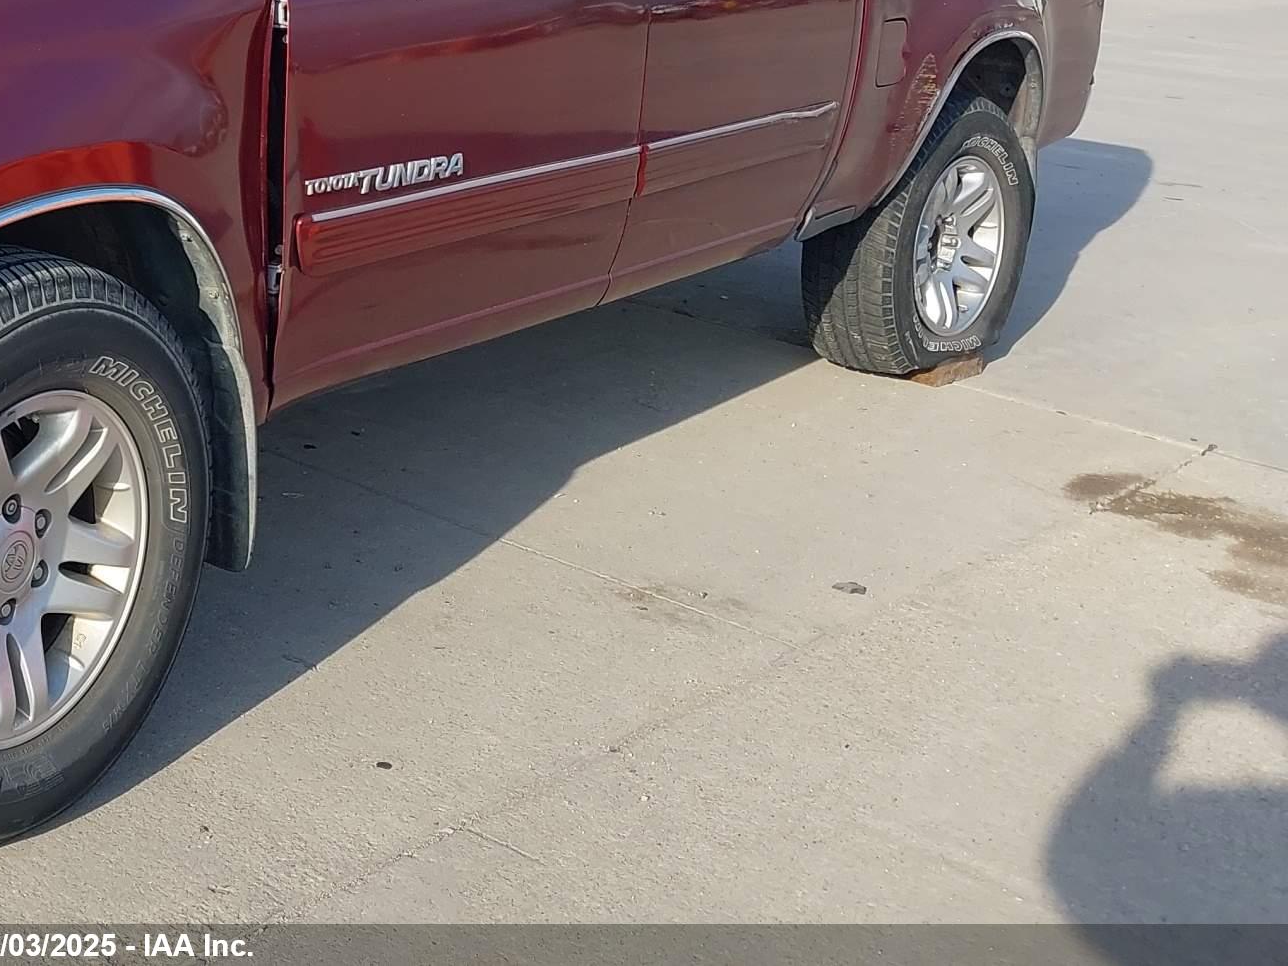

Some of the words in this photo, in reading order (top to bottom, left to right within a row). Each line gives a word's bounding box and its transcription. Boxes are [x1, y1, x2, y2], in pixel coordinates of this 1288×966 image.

[305, 171, 361, 196] TOYOTA
[359, 152, 464, 195] TUNDRA
[87, 355, 191, 524] MICHELIN
[145, 537, 185, 656] DEFENDER
